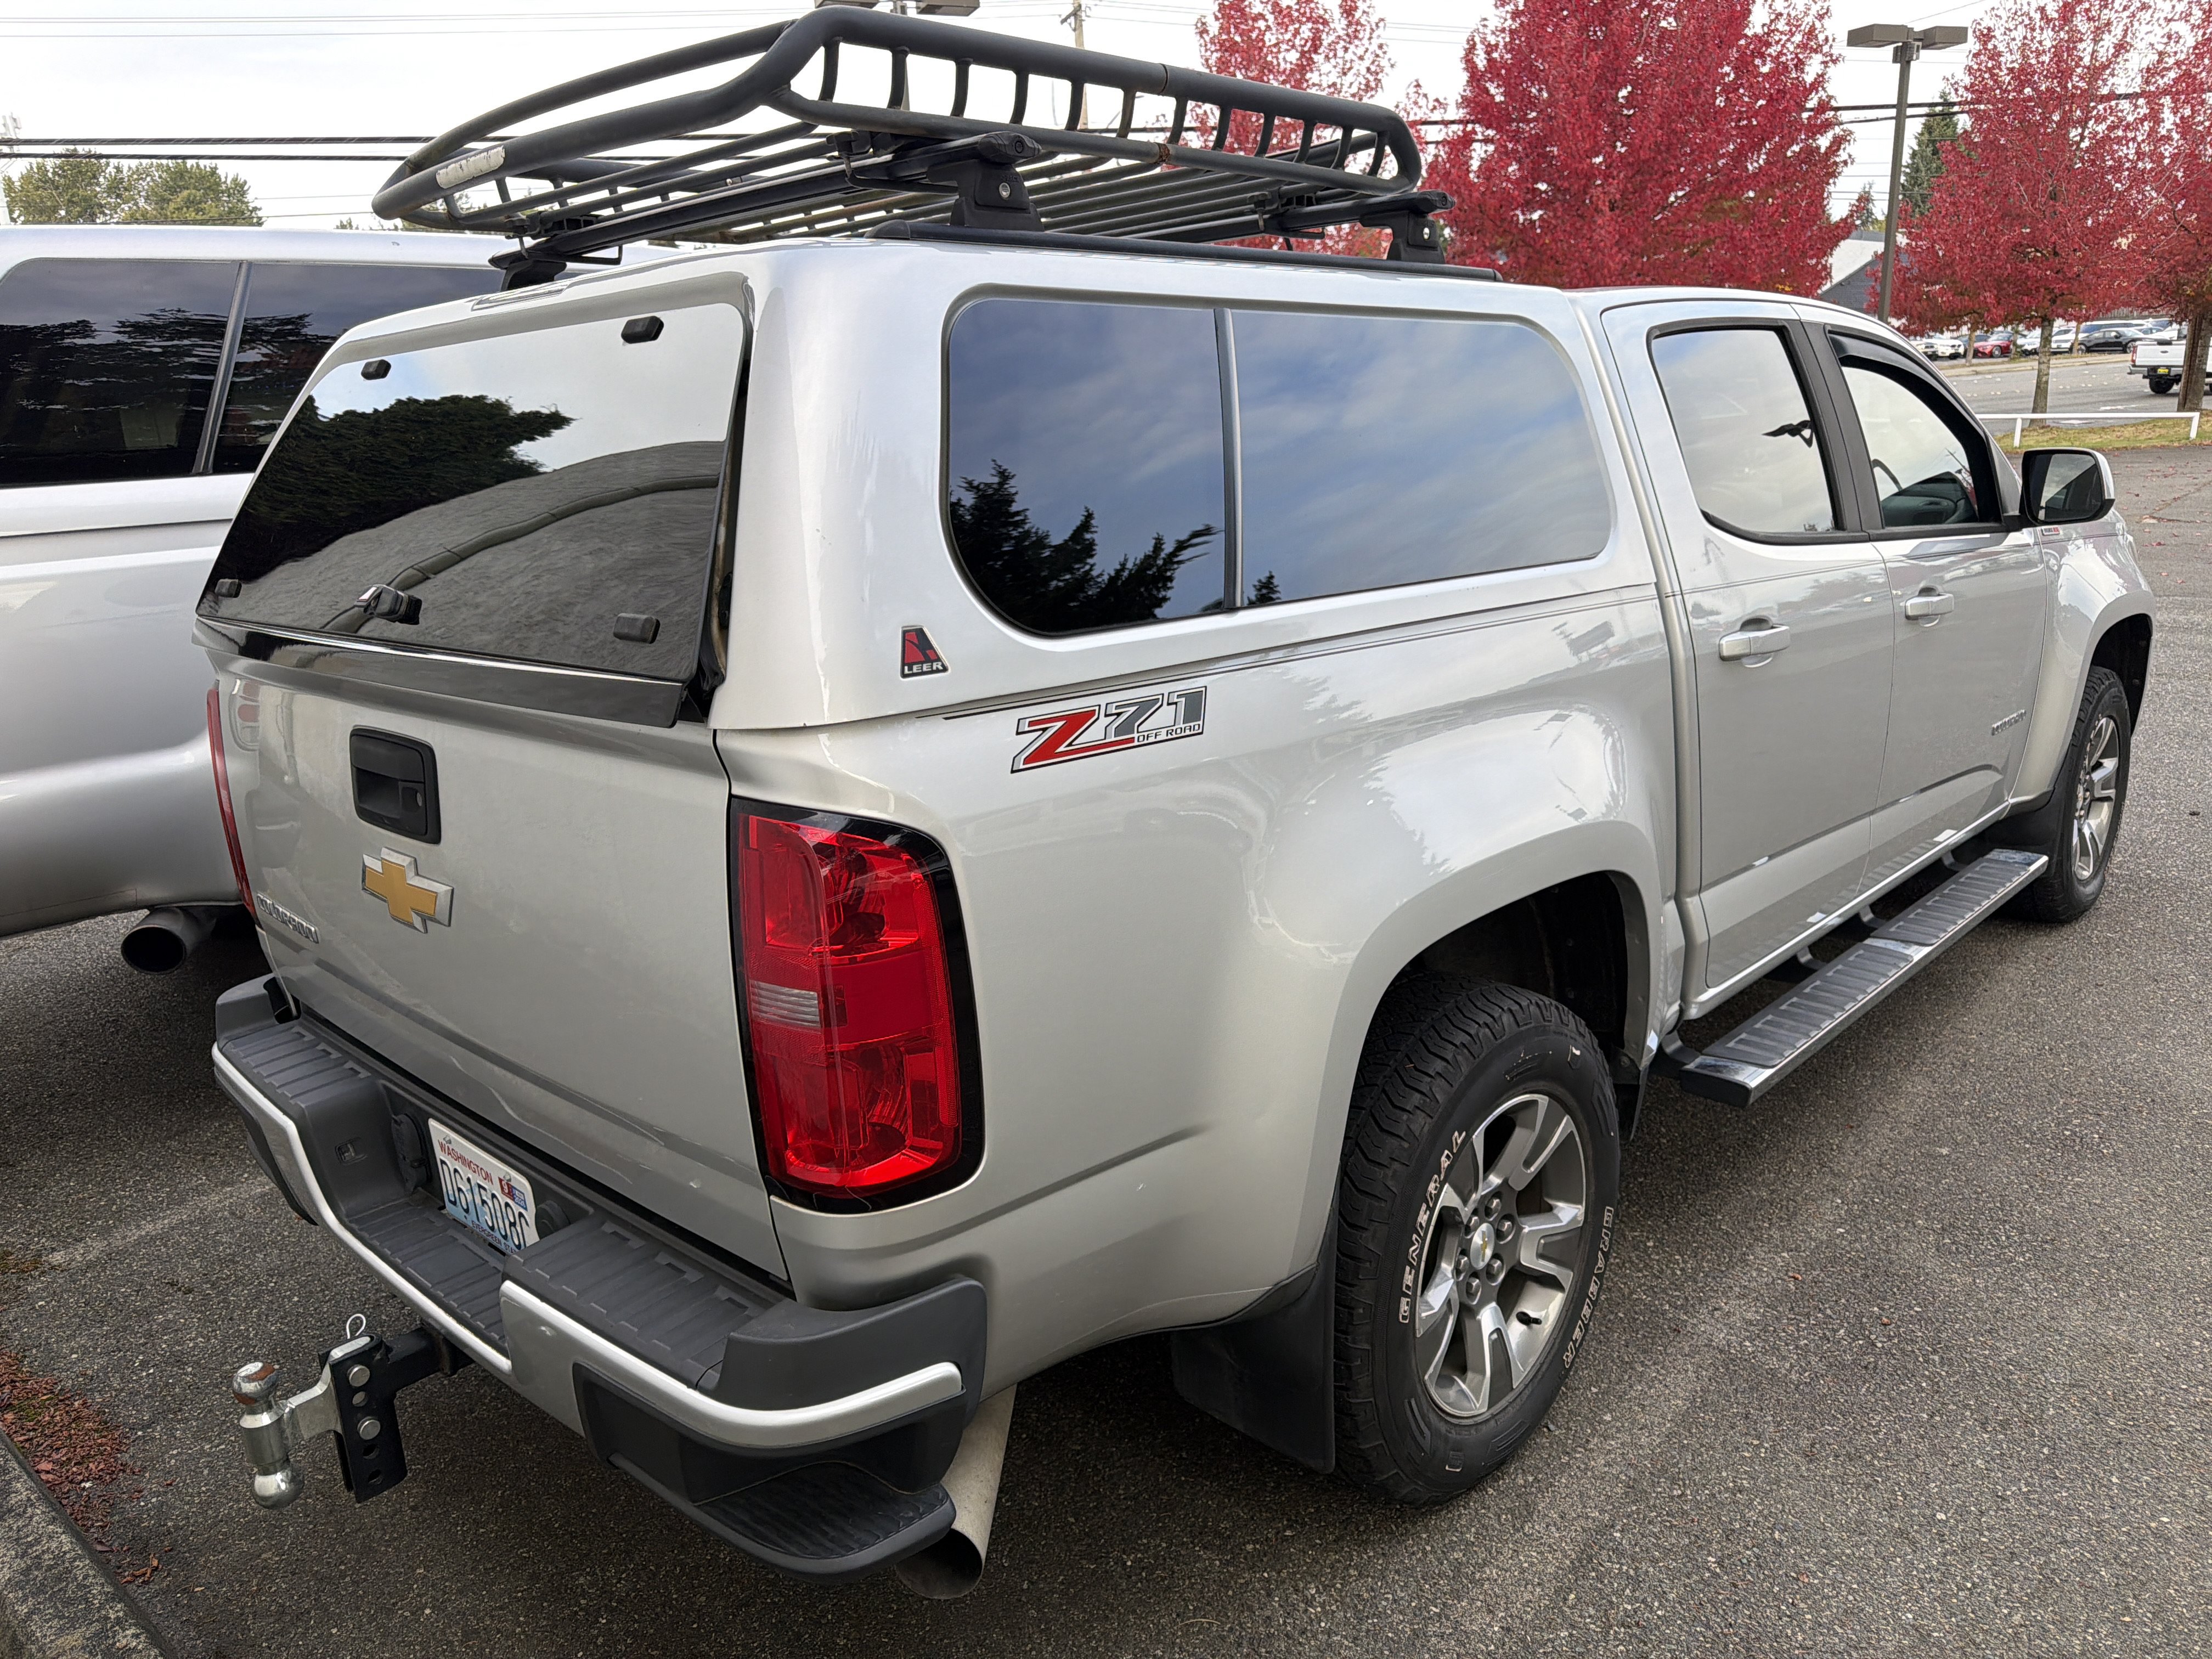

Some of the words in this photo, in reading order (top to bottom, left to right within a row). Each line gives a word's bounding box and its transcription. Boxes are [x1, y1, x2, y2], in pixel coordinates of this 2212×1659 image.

[904, 662, 944, 675] LEER
[1011, 686, 1207, 774] Z71
[1137, 731, 1163, 743] OFF
[1165, 723, 1201, 737] ROAD
[438, 1139, 494, 1186] WASHINGTON
[501, 1180, 509, 1193] 9
[1398, 1130, 1466, 1324] GENERAL
[1562, 1206, 1614, 1369] GRABBER
